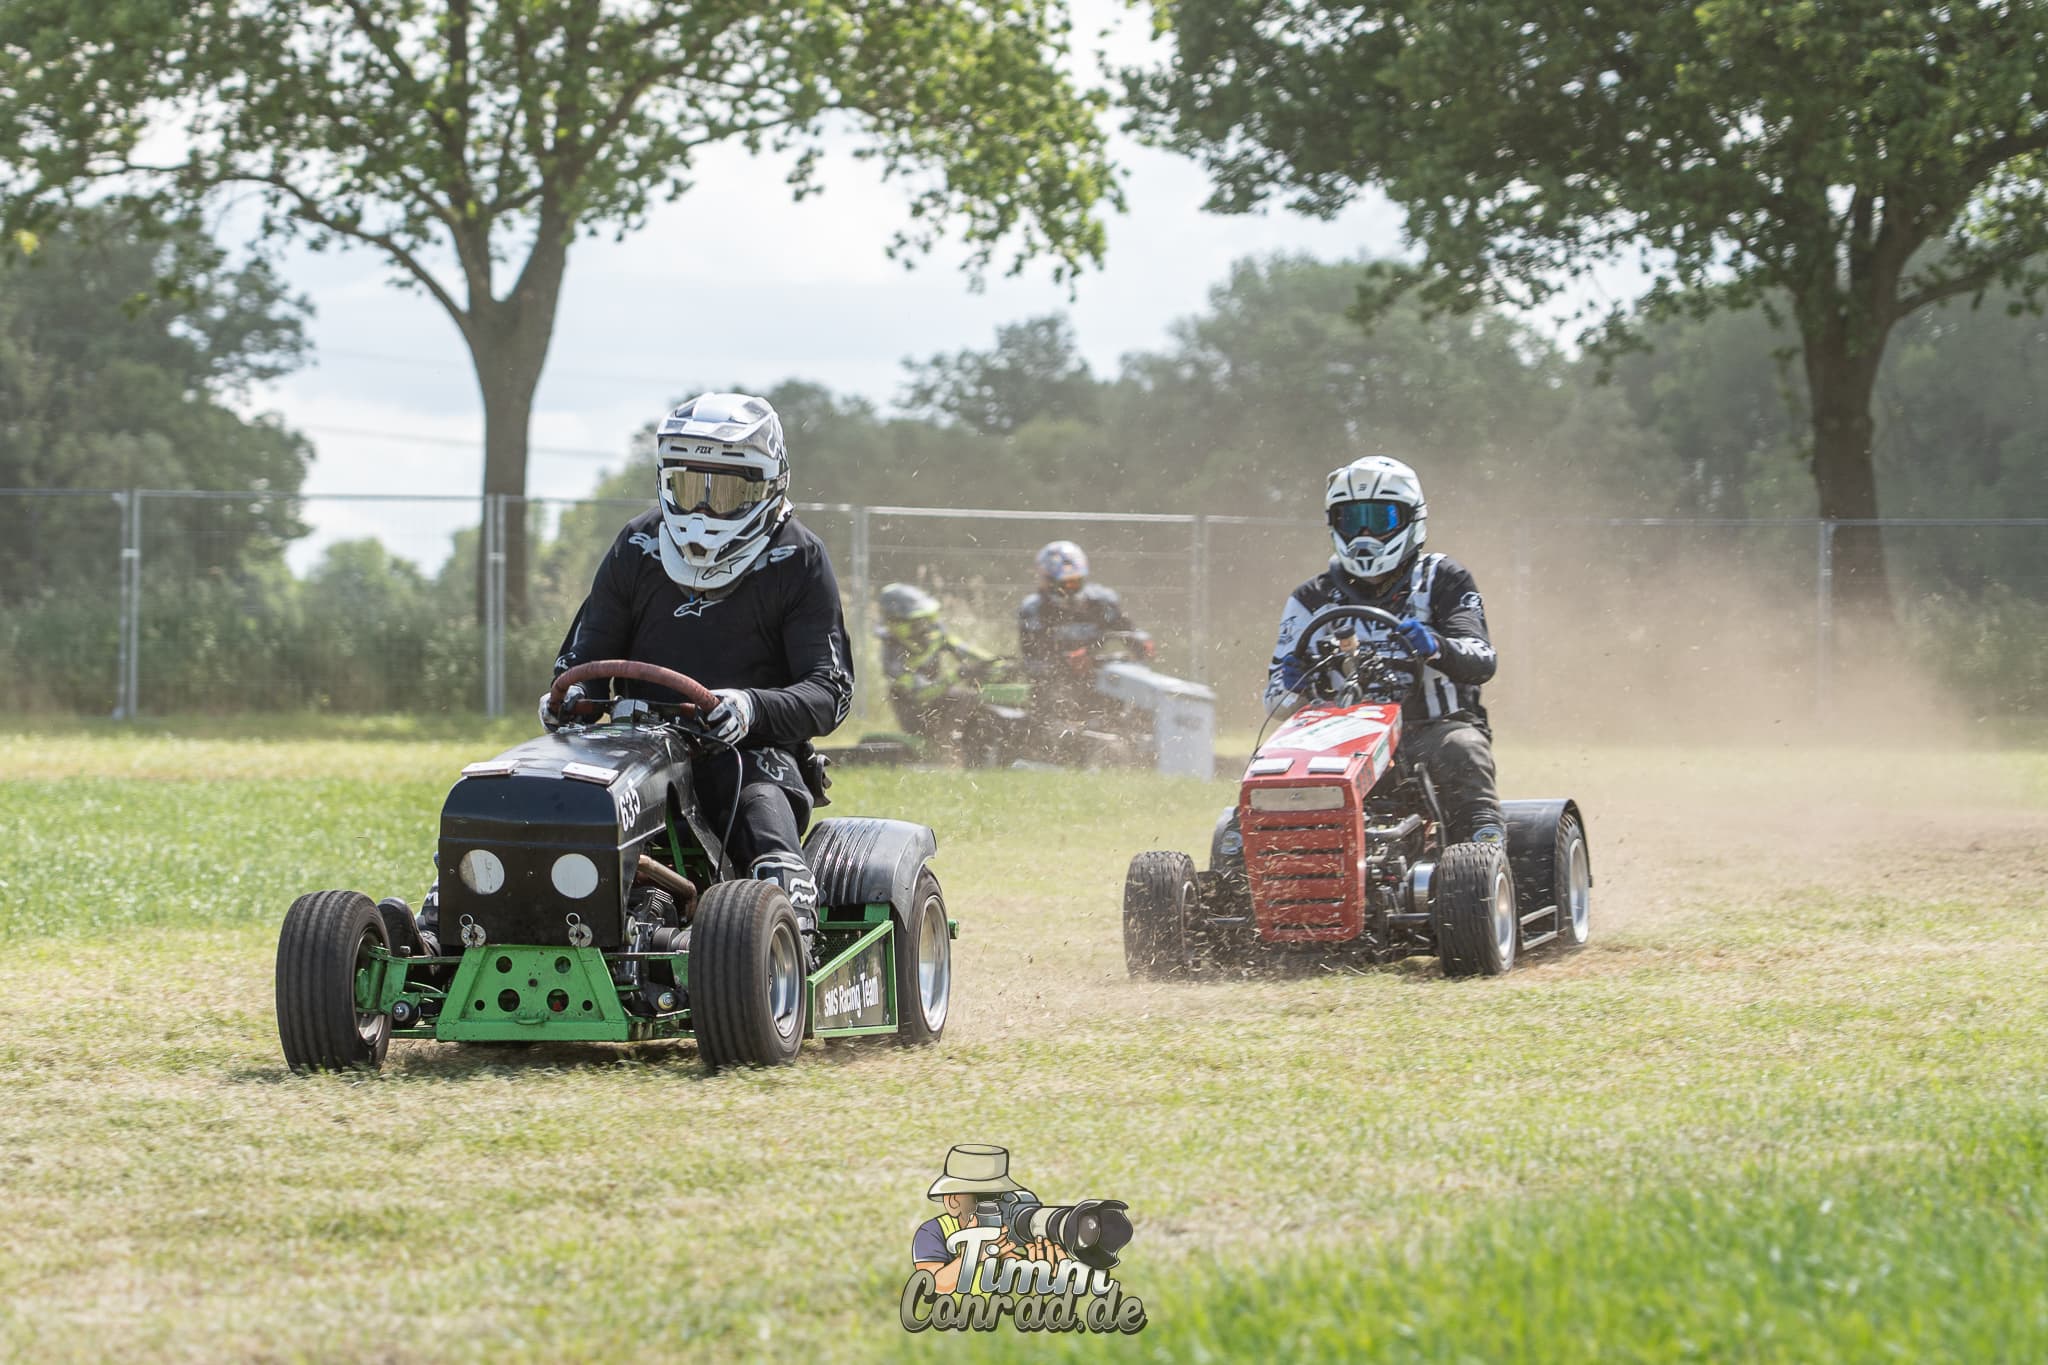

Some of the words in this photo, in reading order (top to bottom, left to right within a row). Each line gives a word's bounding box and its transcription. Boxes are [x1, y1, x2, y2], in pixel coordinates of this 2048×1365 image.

[619, 778, 640, 832] 635
[839, 979, 861, 1019] Racing
[860, 972, 879, 1008] Team
